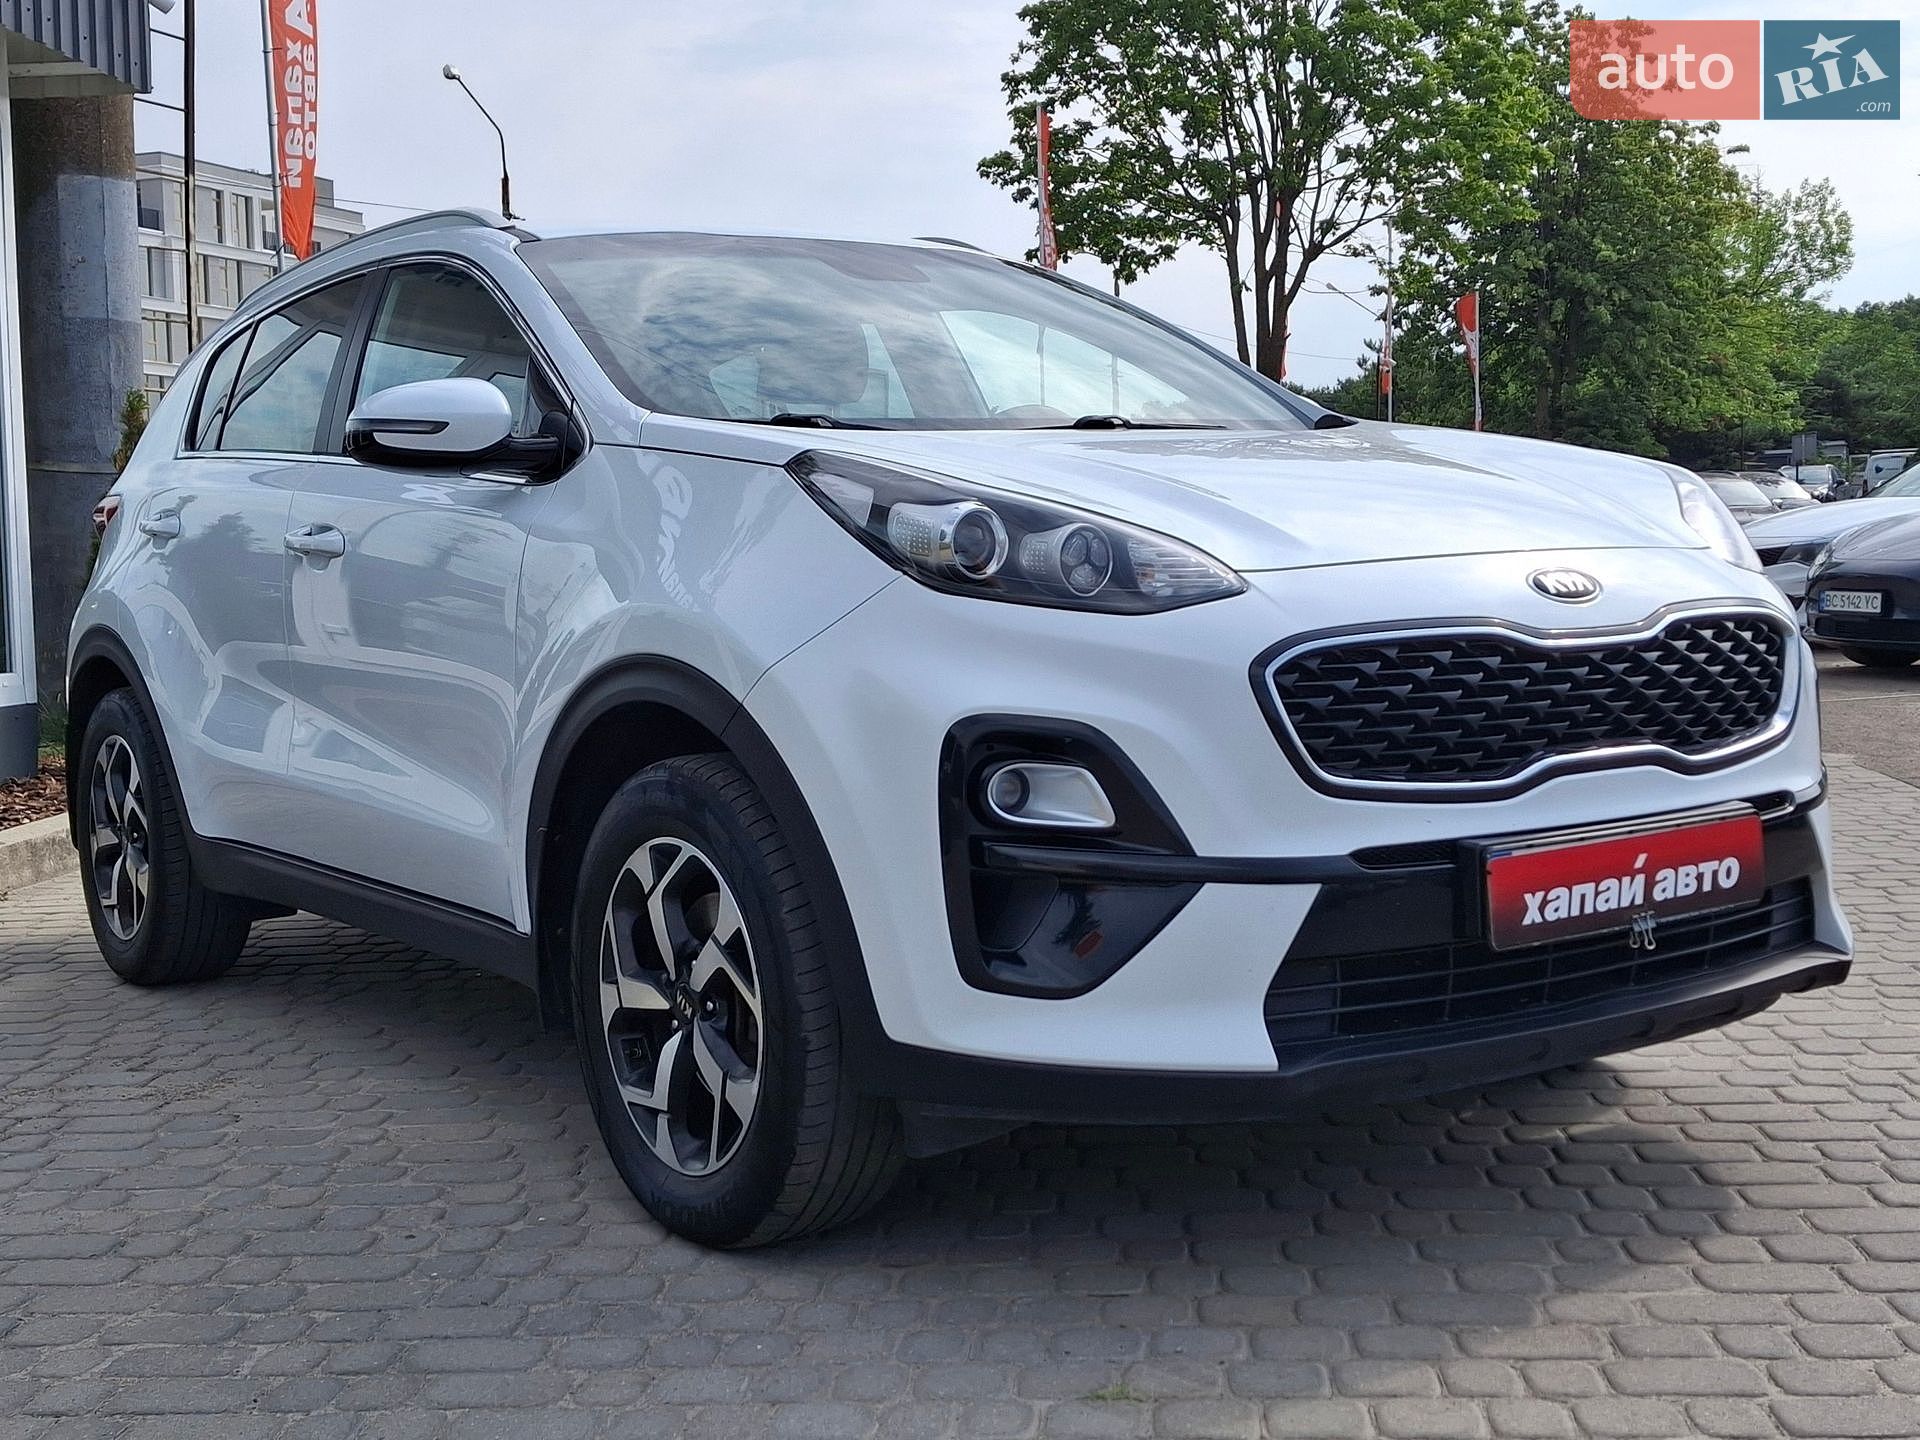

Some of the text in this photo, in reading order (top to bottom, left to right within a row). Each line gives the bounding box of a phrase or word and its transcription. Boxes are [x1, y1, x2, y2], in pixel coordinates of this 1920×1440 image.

[1825, 594, 1879, 610] BC 5142 YC
[1652, 856, 1741, 902] авто
